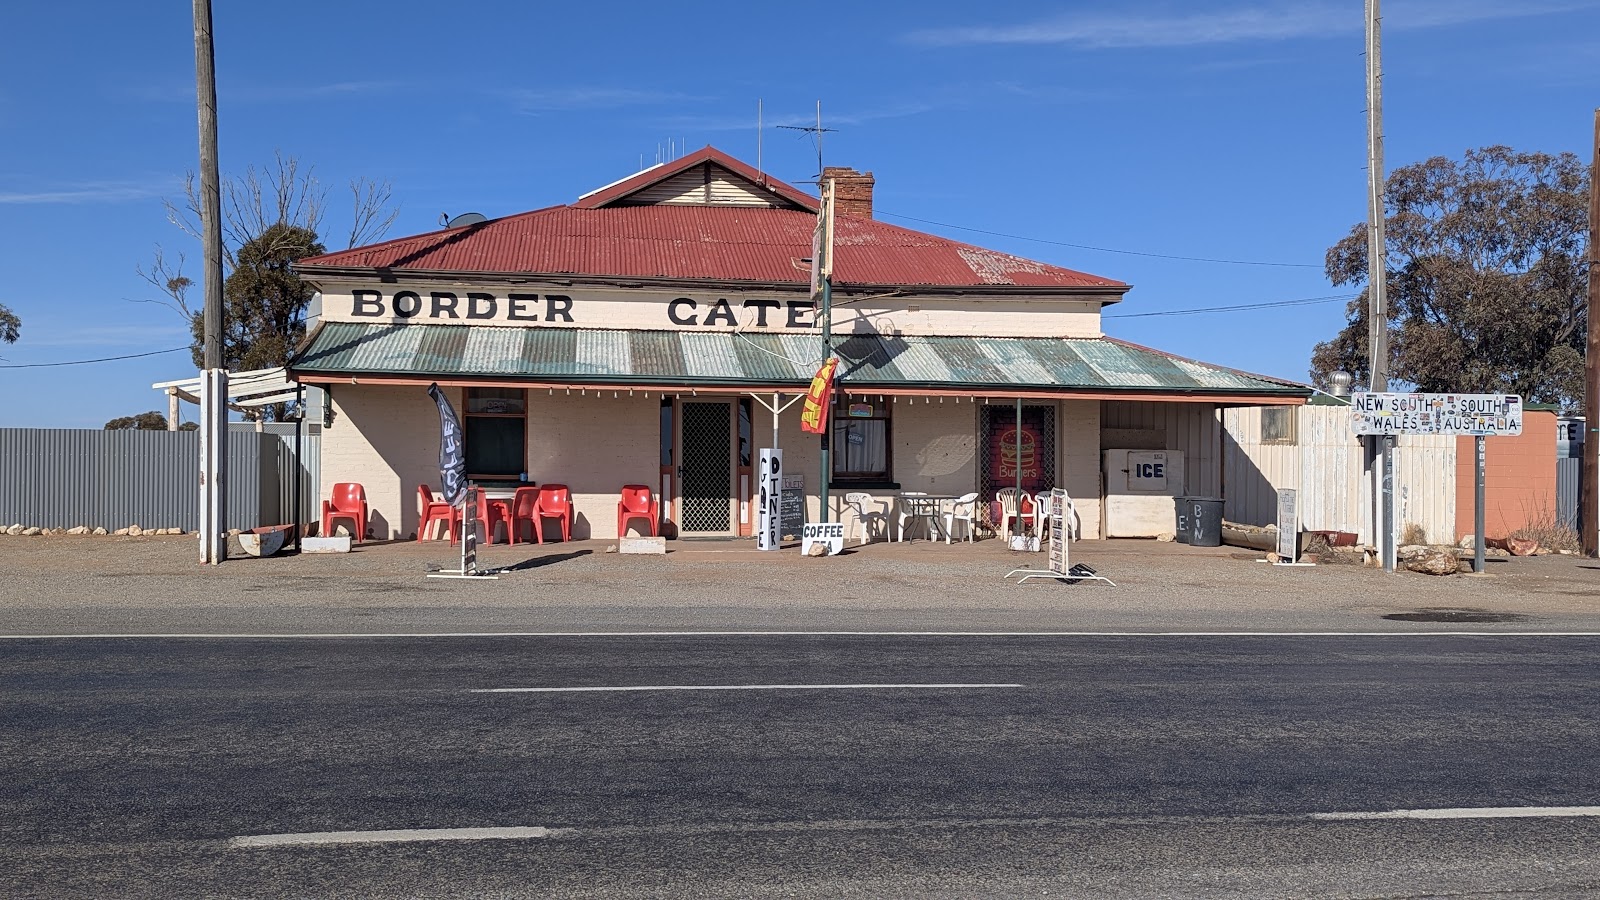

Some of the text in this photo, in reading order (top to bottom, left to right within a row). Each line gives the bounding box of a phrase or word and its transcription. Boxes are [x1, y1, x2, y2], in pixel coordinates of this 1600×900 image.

[351, 289, 818, 328] BORDER GATE
[1356, 398, 1384, 411] NEW
[1391, 398, 1434, 412] SOUTH
[1460, 399, 1502, 413] SOUTH
[1373, 416, 1418, 430] WALES
[1443, 416, 1518, 431] AUSTRALIA
[1000, 465, 1038, 480] Burers
[1136, 463, 1164, 478] ICE
[769, 456, 780, 546] DINER
[1193, 504, 1204, 540] BIN
[803, 525, 844, 538] COFFEE
